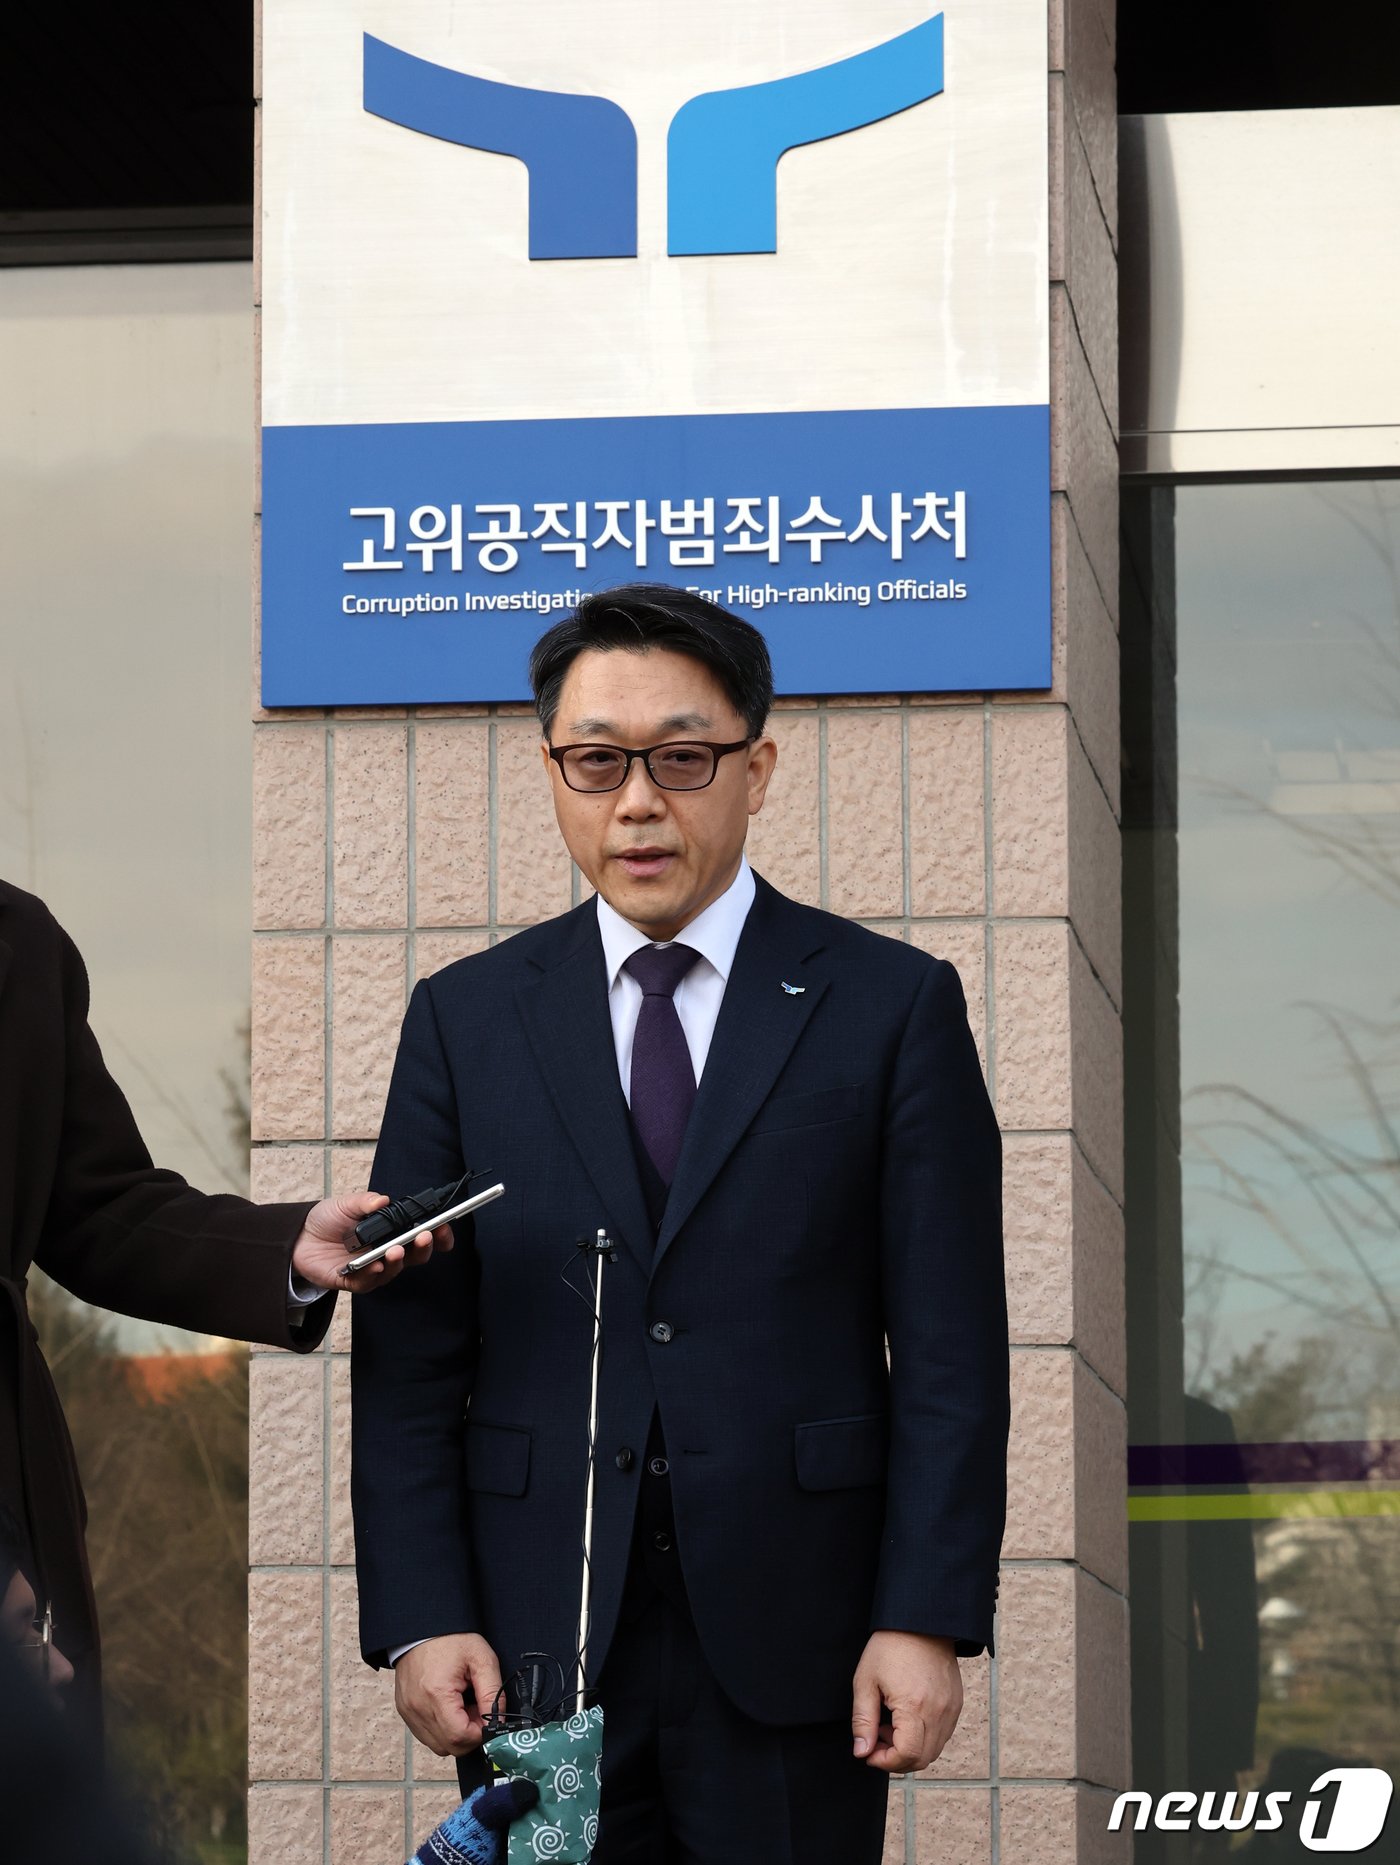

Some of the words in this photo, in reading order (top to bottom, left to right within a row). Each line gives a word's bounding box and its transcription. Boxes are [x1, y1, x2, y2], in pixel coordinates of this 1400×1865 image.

[342, 490, 967, 573] 고위공직자범죄수사처
[342, 592, 459, 617] Corruption
[727, 581, 871, 609] High-ranking
[877, 578, 967, 601] Officials
